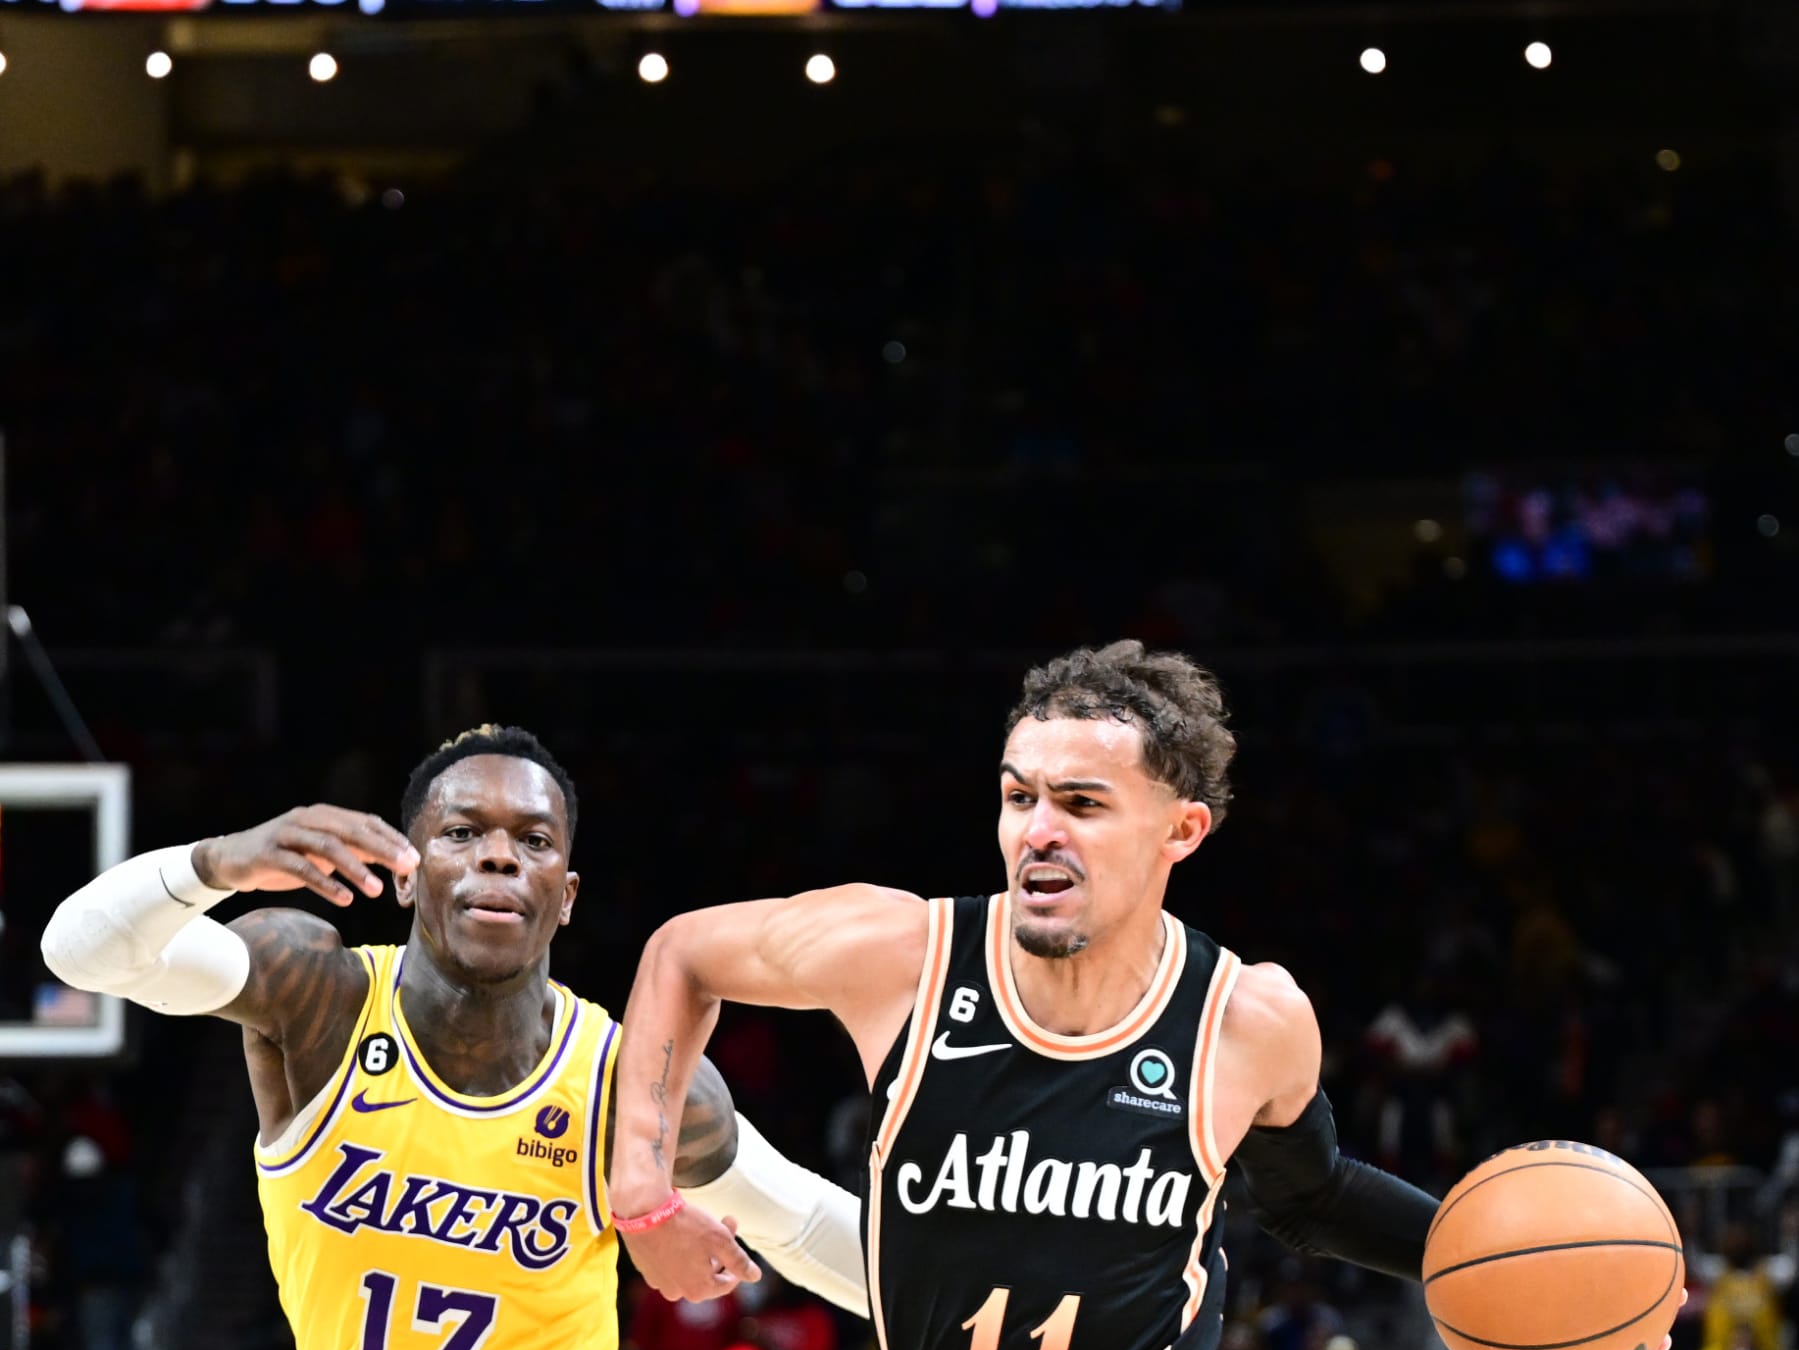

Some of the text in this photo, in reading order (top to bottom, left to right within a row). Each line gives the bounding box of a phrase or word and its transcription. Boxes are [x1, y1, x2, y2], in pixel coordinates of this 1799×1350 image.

[948, 986, 980, 1023] 6
[364, 1037, 390, 1073] 6
[1113, 1091, 1182, 1114] sharecare
[516, 1137, 578, 1168] bibigo
[897, 1129, 1192, 1228] Atlanta
[301, 1142, 579, 1271] LAKERS
